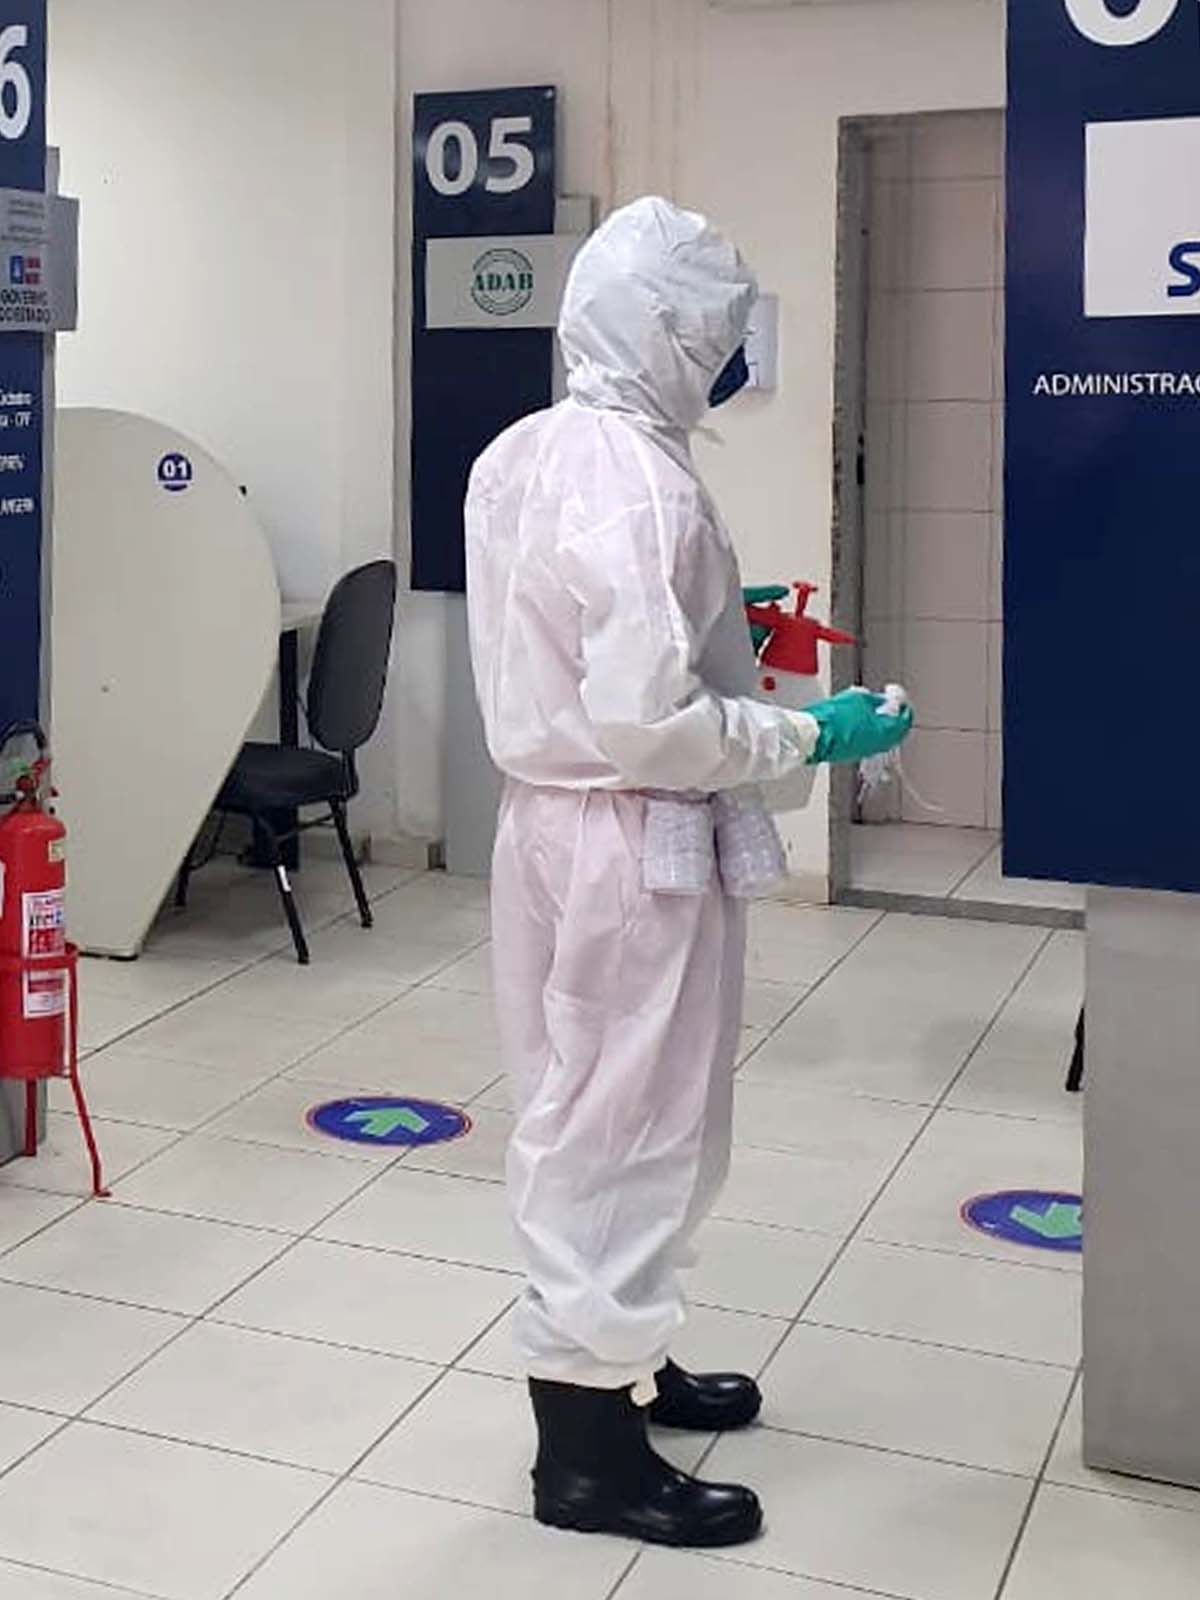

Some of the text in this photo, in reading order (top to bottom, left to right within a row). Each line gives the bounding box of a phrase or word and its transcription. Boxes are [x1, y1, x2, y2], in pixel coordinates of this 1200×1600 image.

[426, 116, 535, 196] 05
[473, 272, 533, 291] ADAB
[1033, 373, 1200, 396] ADMINISTRA
[163, 460, 187, 478] 01
